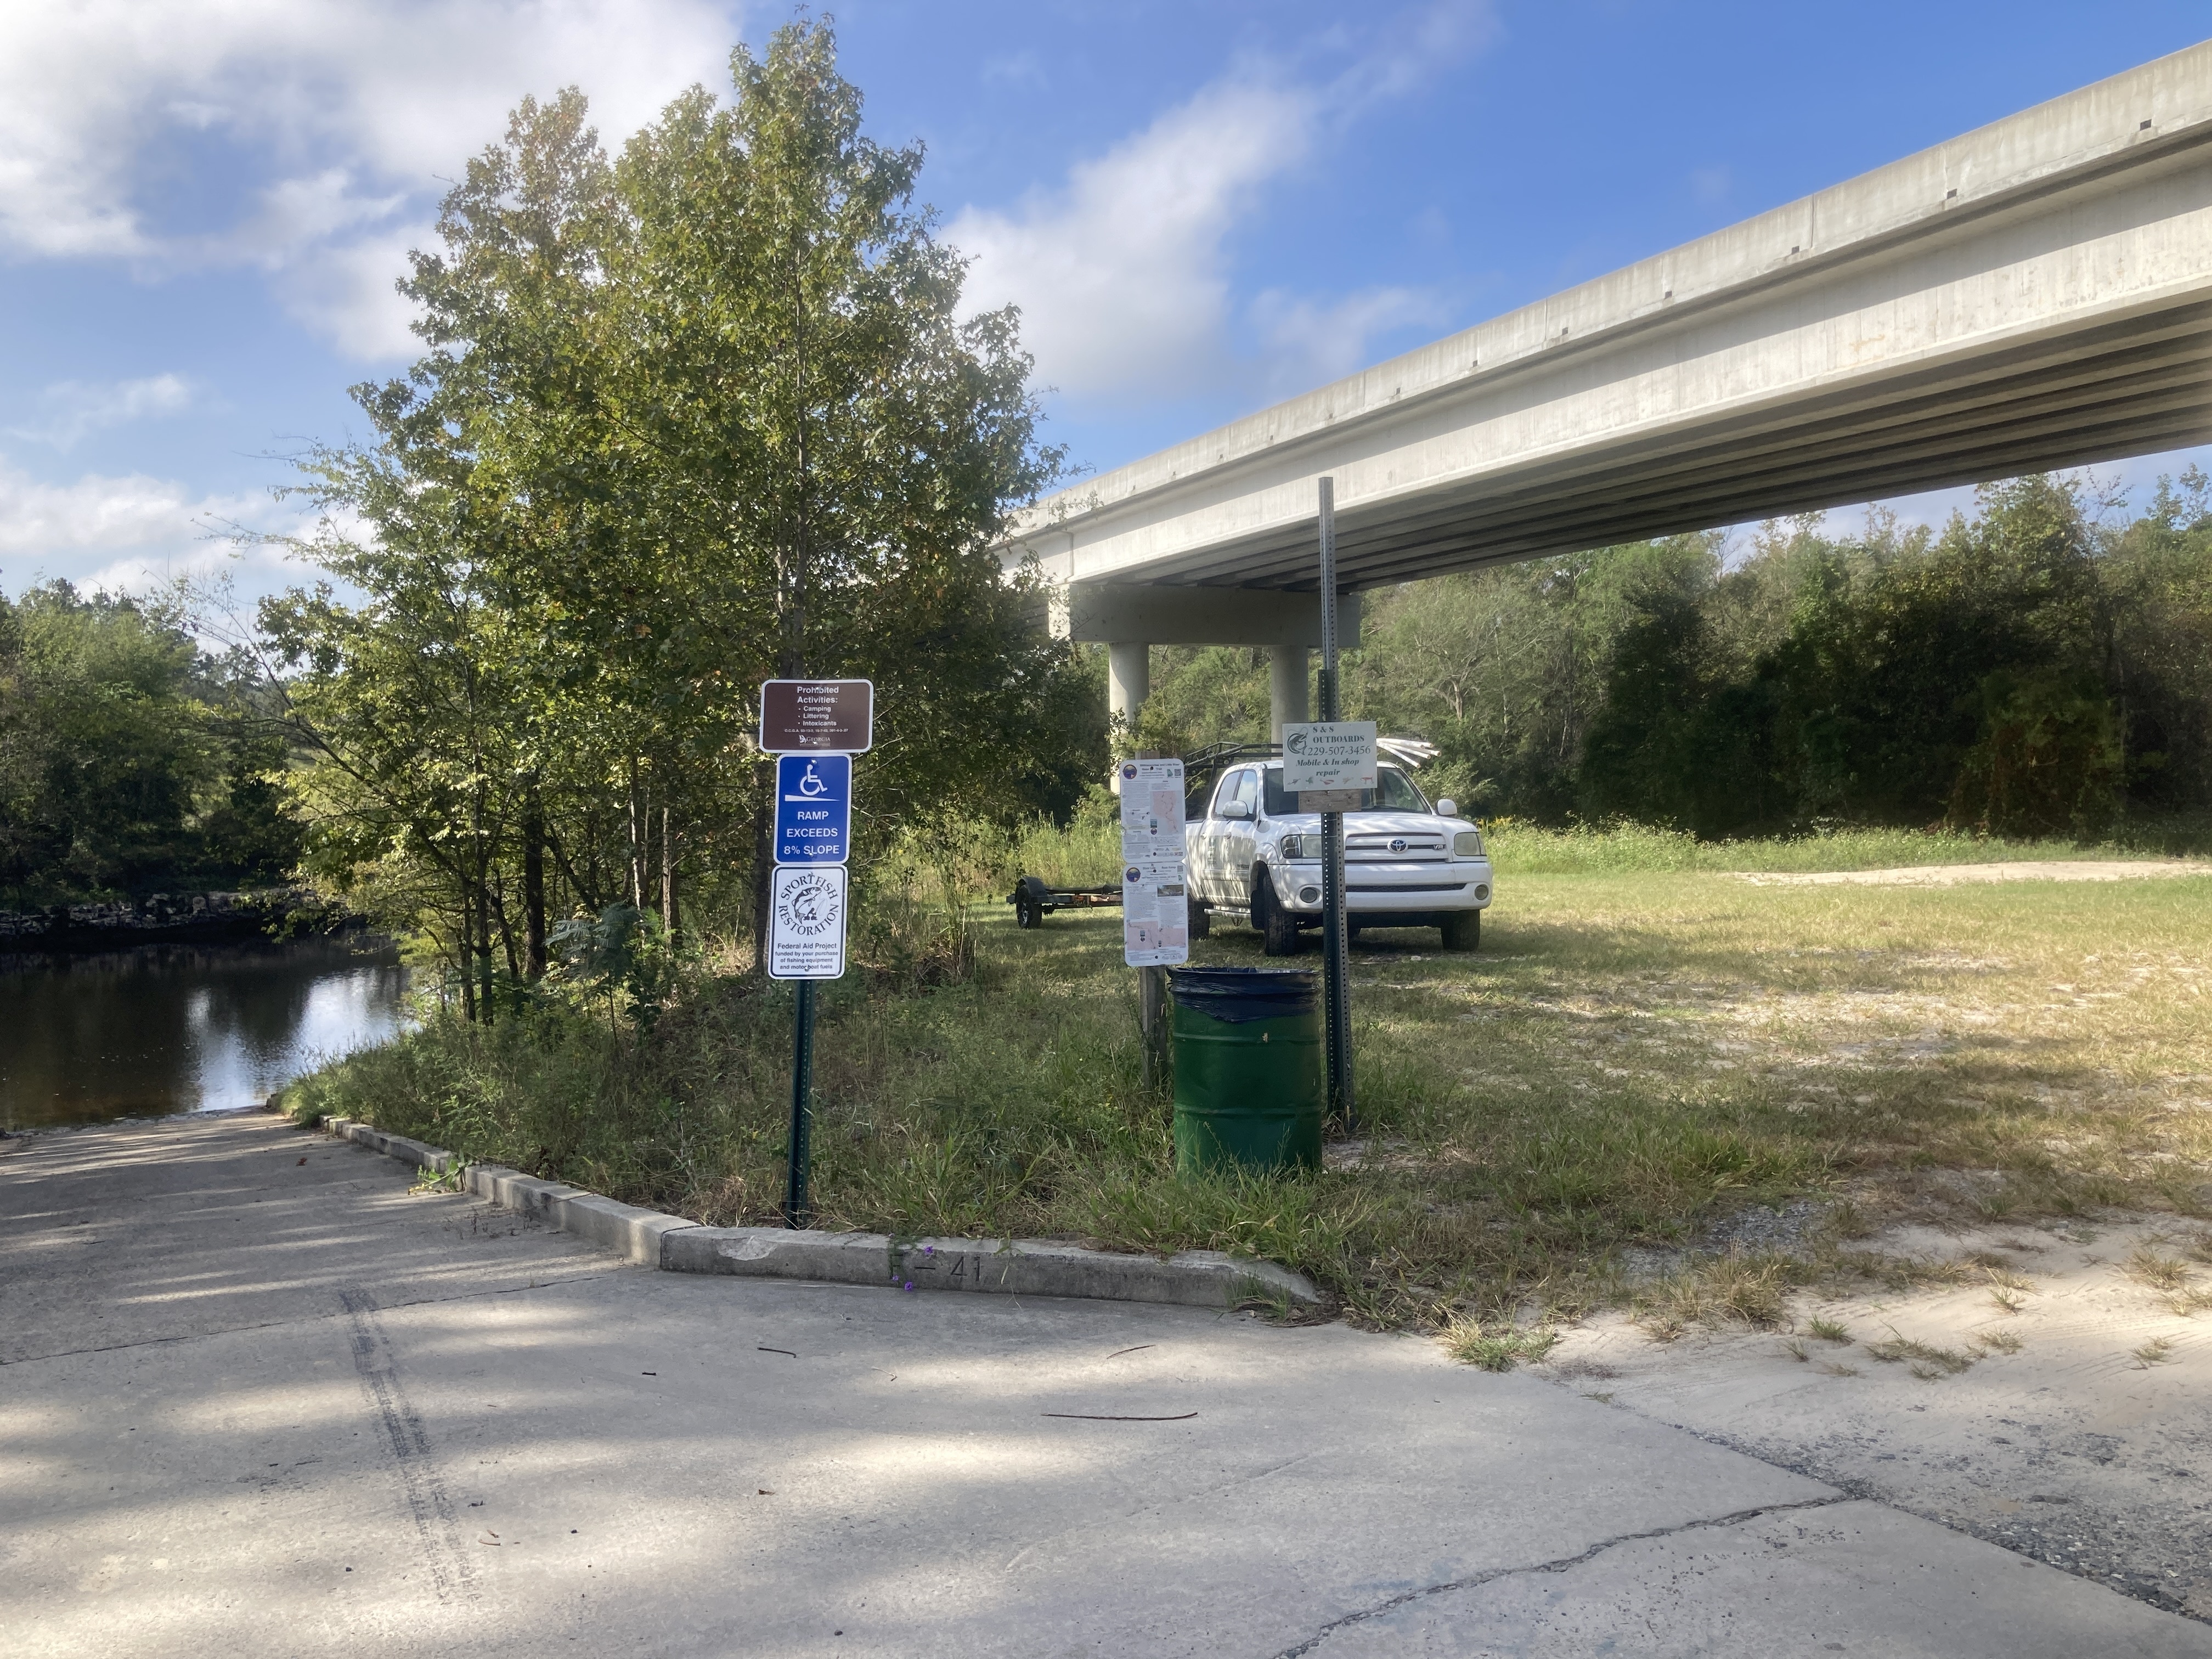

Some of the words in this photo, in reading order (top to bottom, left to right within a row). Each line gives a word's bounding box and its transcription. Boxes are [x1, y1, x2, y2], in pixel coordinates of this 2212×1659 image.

[1313, 735, 1365, 744] OUTBOARDS
[1307, 745, 1371, 756] 229-507-3456
[1296, 759, 1321, 767] Mobile
[1341, 758, 1359, 766] shop
[1316, 769, 1341, 777] repair
[797, 811, 829, 820] RAMP
[787, 827, 838, 838] EXCEEDS
[783, 845, 800, 855] 8%
[803, 845, 840, 855] SLOPE
[781, 874, 815, 900] SPORT
[815, 876, 839, 900] FISH
[778, 903, 839, 936] RESTORATION
